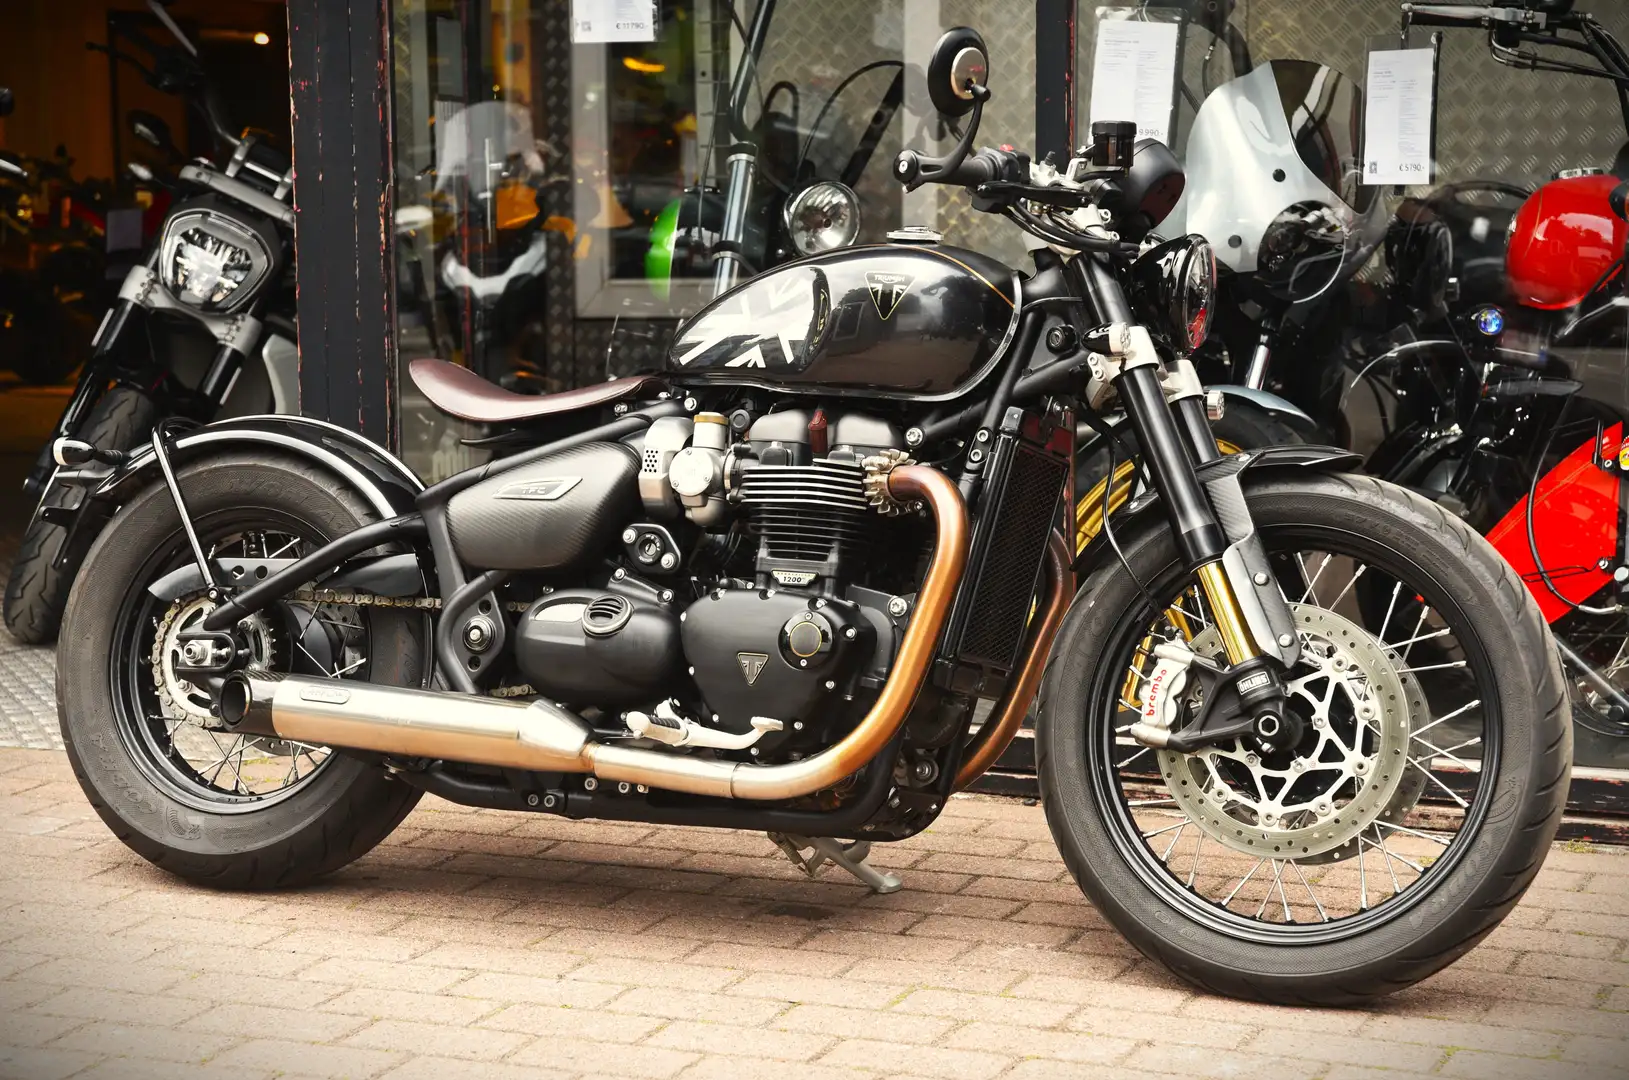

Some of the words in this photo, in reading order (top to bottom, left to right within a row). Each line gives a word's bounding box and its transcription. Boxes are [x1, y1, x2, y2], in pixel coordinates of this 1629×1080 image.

[874, 274, 905, 283] TRIUMPH
[521, 487, 546, 495] TFC
[1145, 669, 1167, 717] brembo
